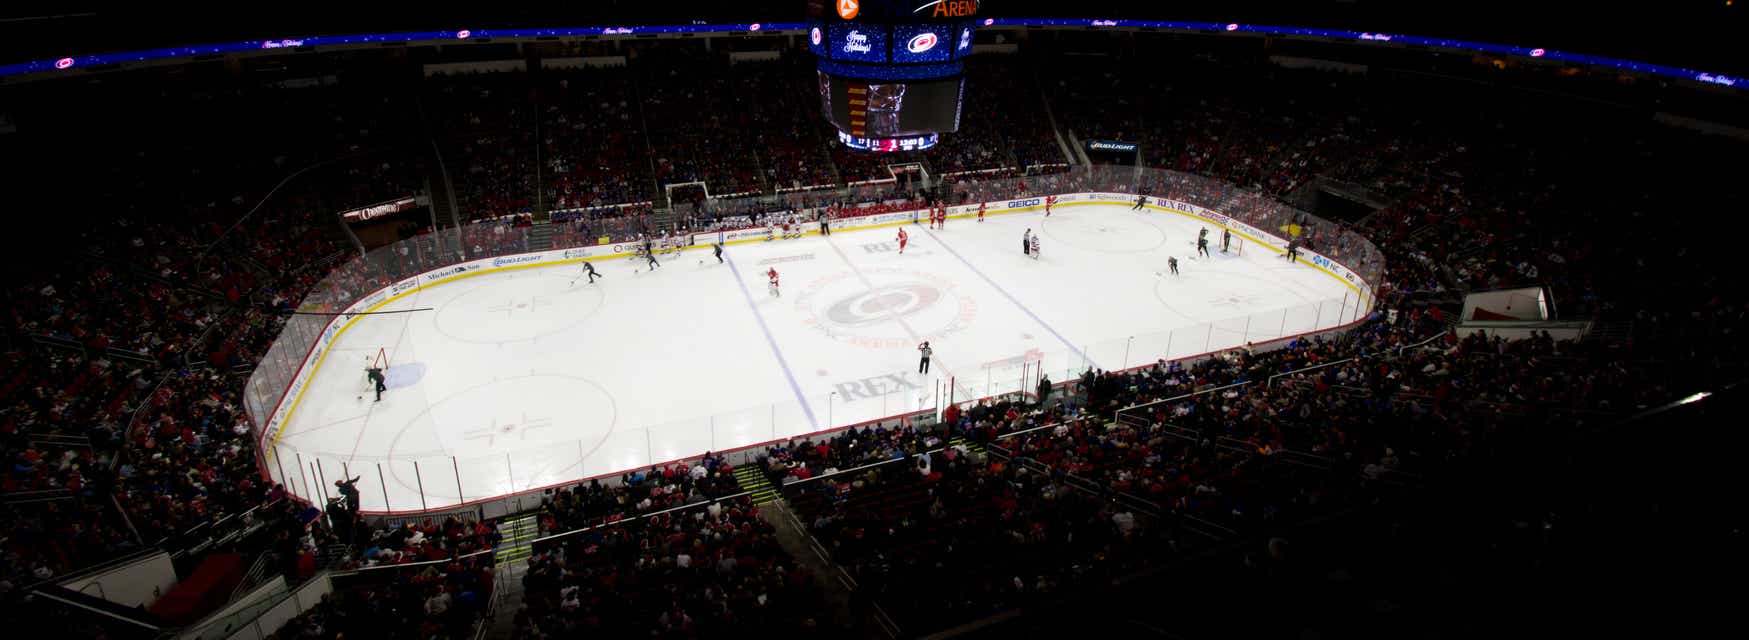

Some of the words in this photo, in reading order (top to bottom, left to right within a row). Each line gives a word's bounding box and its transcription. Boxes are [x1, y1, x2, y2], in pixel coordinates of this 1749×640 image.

[932, 0, 976, 17] ARENA
[1007, 199, 1040, 209] GEICO
[428, 268, 454, 280] Michael
[835, 371, 922, 402] REX
